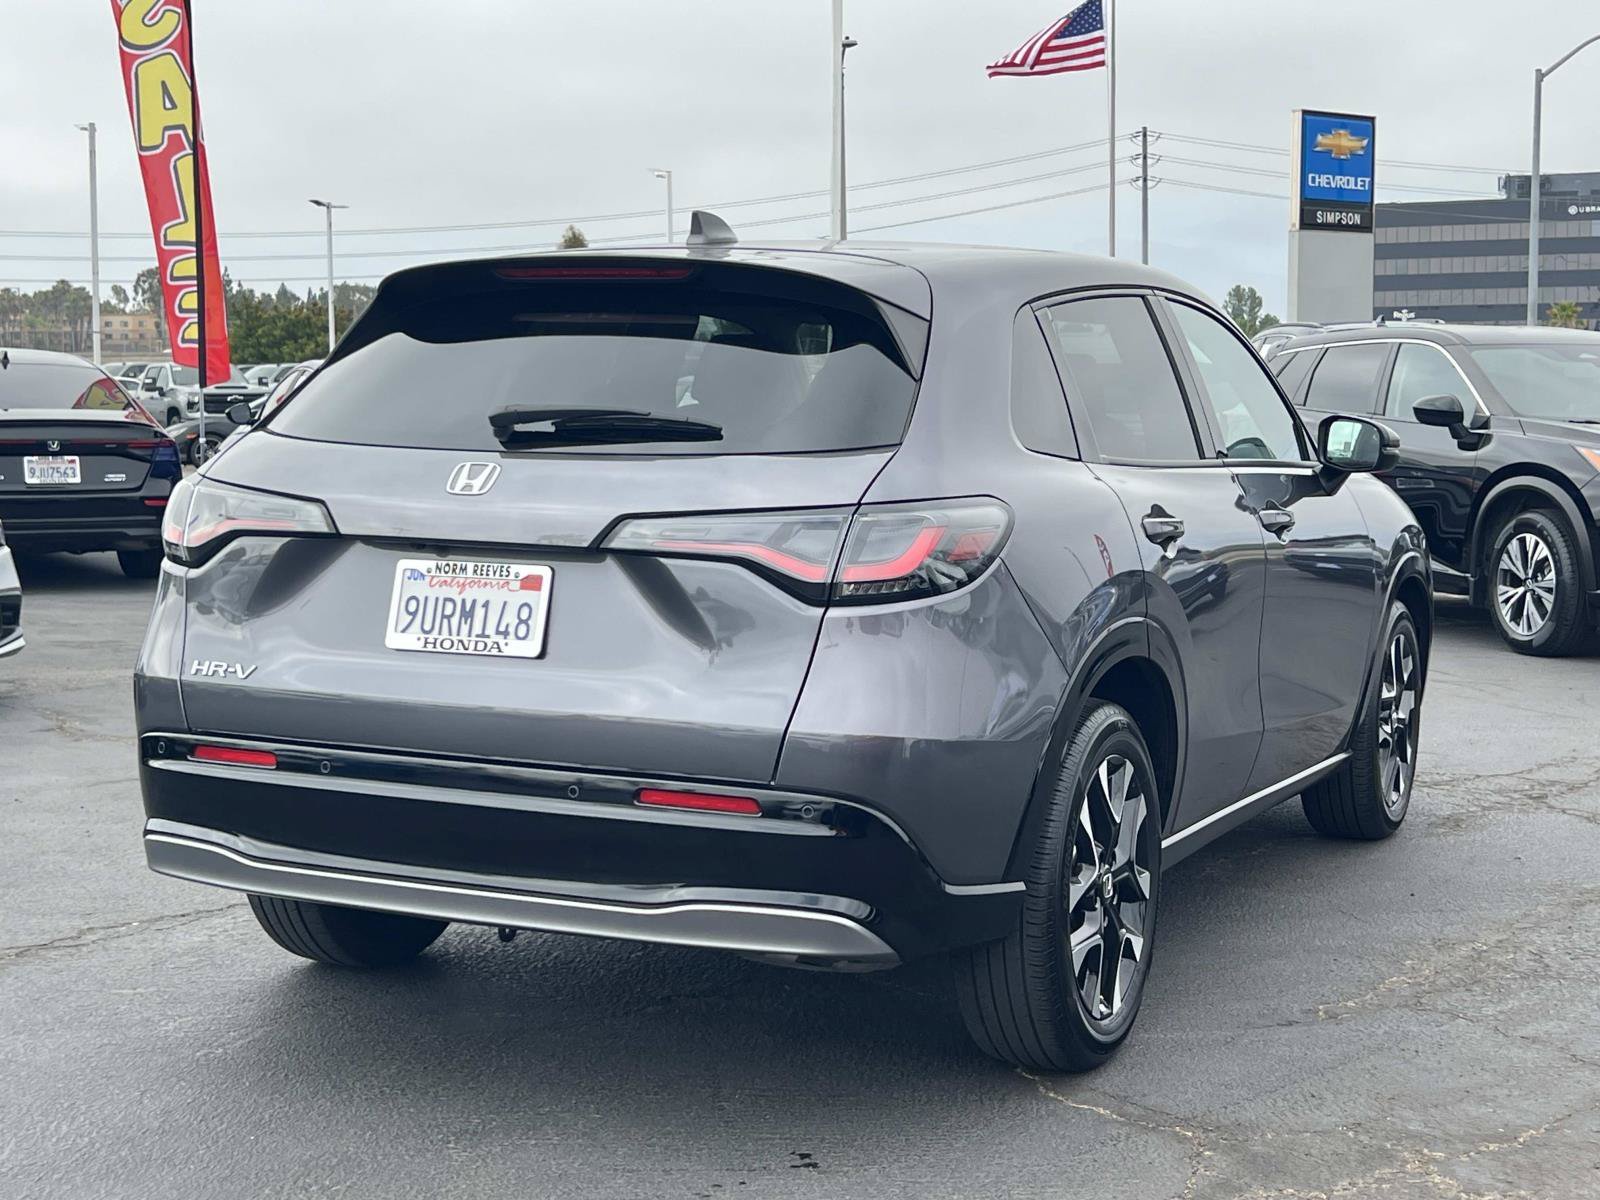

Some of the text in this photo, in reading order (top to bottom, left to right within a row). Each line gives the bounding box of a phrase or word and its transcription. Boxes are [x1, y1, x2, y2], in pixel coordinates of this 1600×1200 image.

[1308, 173, 1370, 190] CHEVROLET
[1316, 210, 1361, 225] SIMPSON
[434, 562, 511, 578] NORM REEVES
[428, 575, 520, 595] California
[400, 595, 533, 641] 9URM148
[421, 636, 504, 653] HONDA
[190, 659, 258, 679] HR-V
